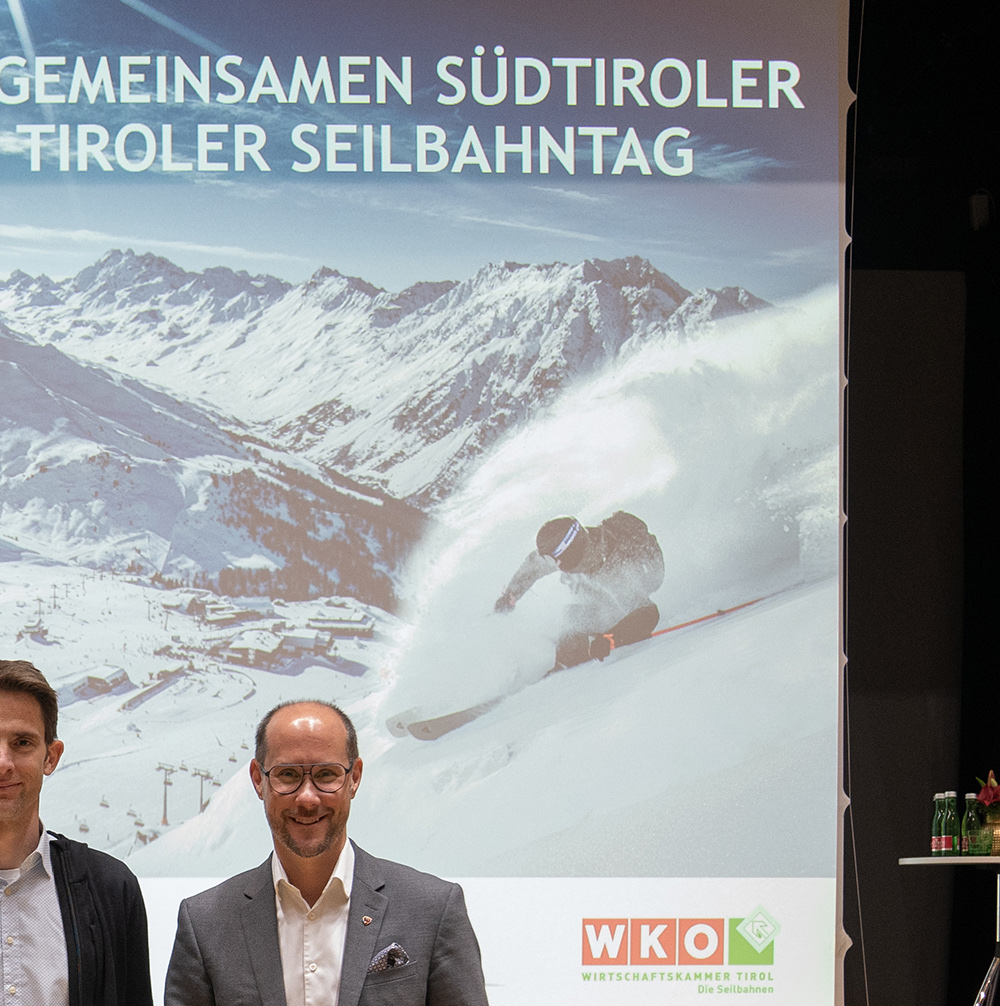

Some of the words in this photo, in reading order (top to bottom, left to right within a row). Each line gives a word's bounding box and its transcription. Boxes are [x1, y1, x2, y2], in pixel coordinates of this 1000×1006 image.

[436, 45, 806, 109] SÜDTIROLER
[16, 123, 272, 172] TIROLER
[291, 123, 694, 176] SEILBAHNTAG
[584, 923, 719, 960] WKO
[582, 972, 731, 982] WIRTSCHAFTSKAMMER
[737, 972, 774, 981] TIROL
[698, 985, 714, 994] Die
[717, 985, 774, 994] Seilbahnen
